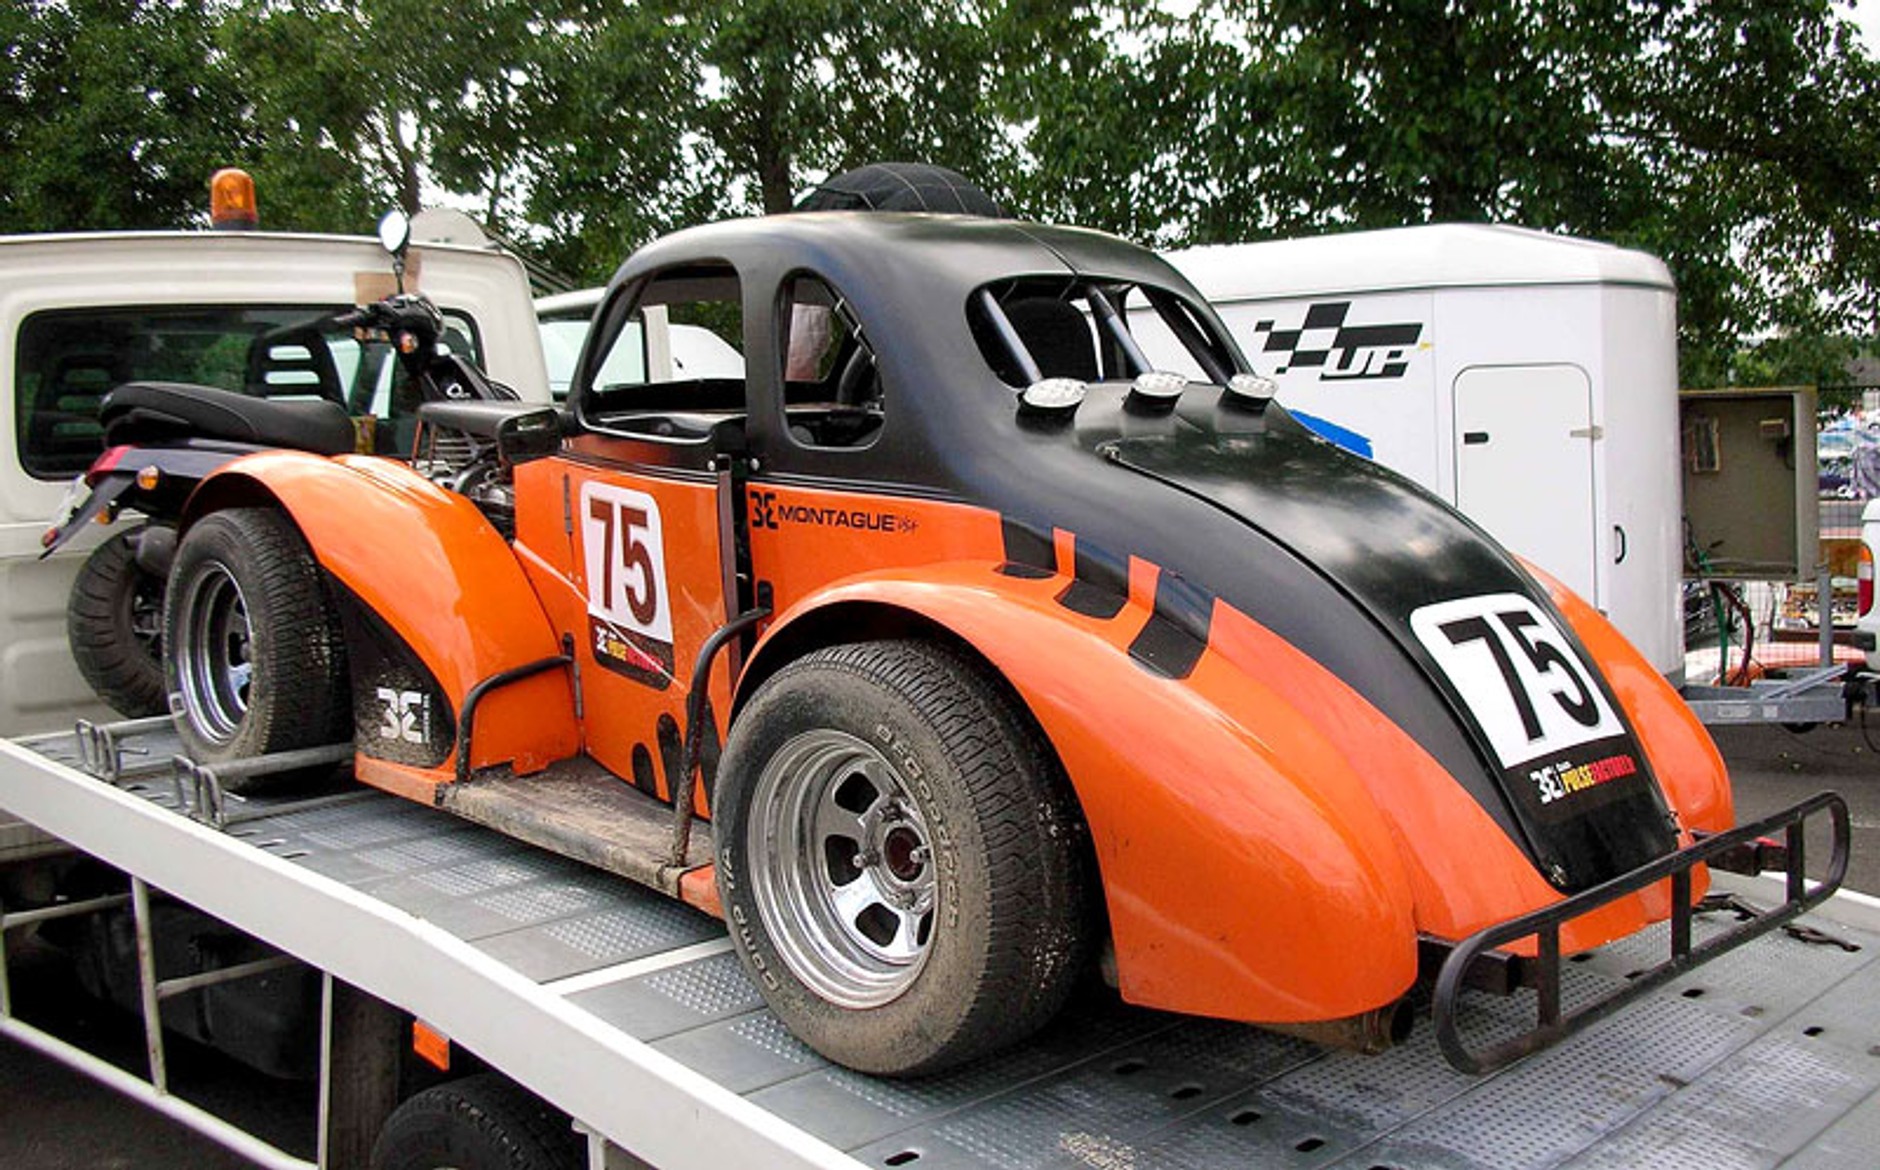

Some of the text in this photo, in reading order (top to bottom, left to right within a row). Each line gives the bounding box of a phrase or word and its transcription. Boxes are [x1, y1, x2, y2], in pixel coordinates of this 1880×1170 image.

[589, 497, 658, 627] 75
[778, 505, 895, 532] MONTAGUE
[1437, 610, 1601, 742] 75
